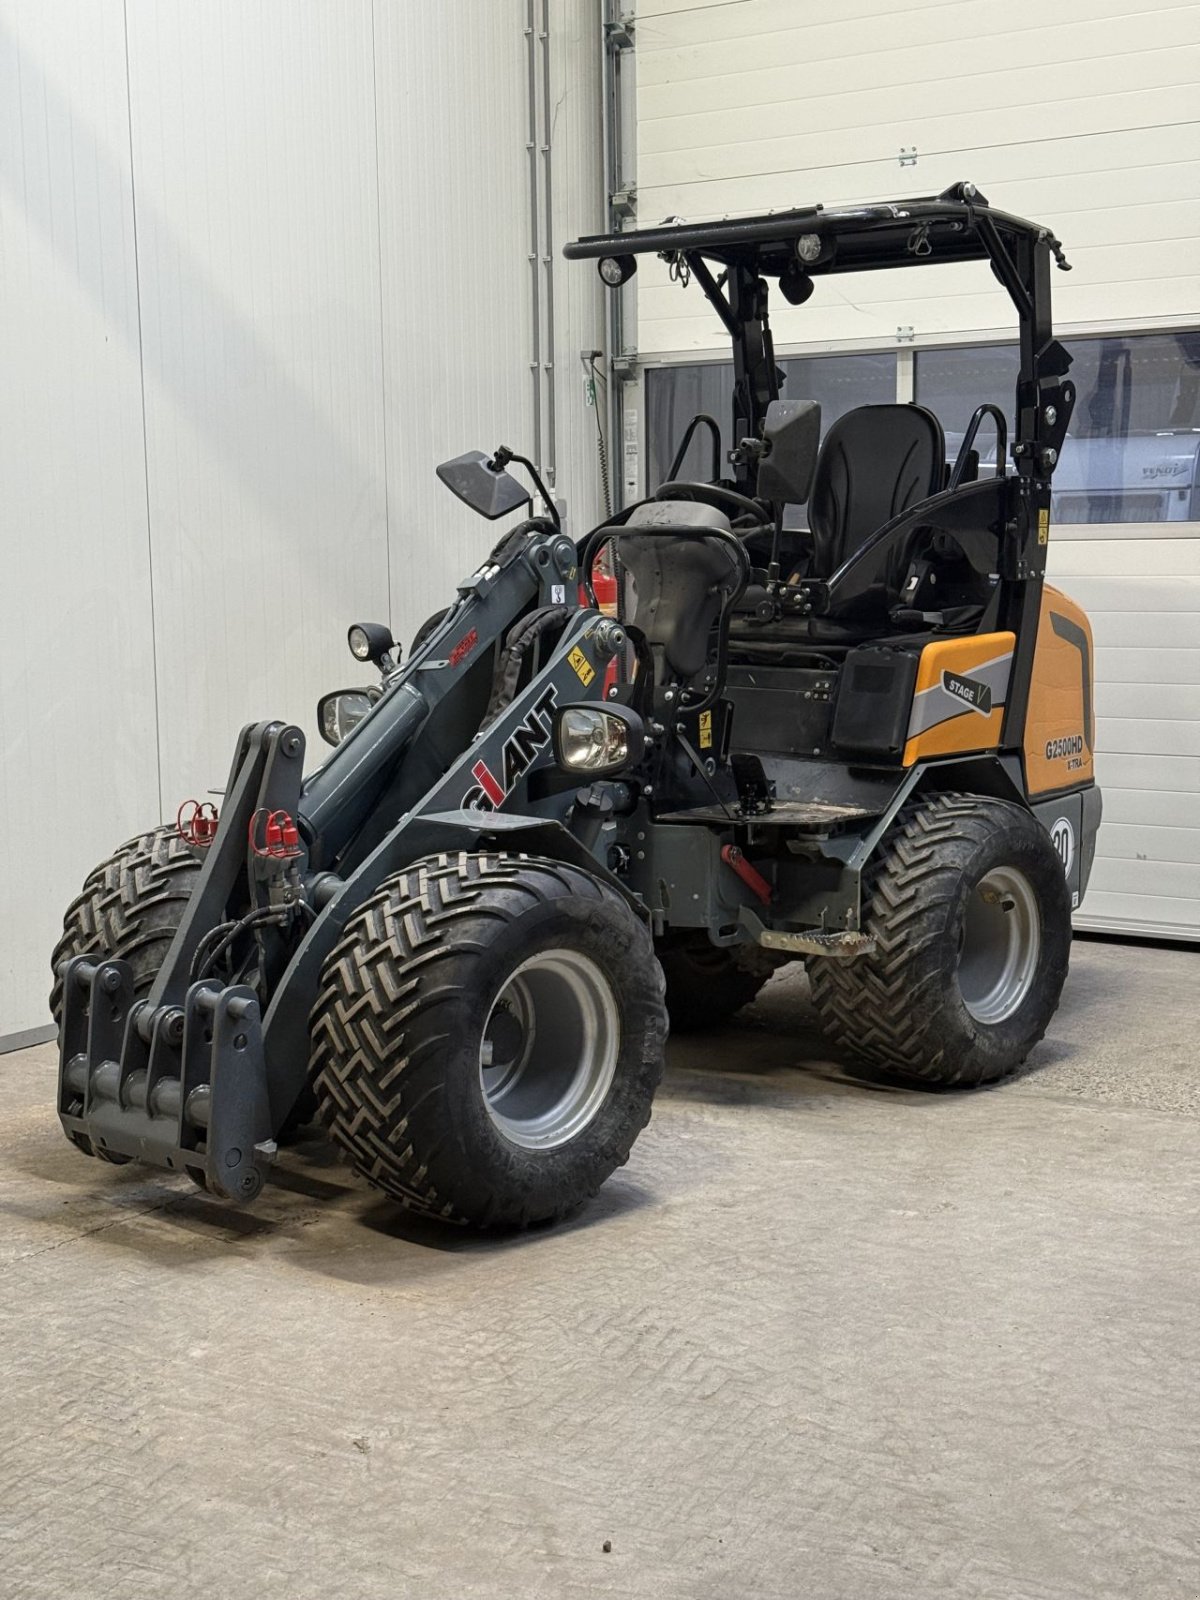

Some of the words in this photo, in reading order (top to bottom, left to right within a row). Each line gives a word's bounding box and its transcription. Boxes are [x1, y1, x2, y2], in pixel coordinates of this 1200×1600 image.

[949, 679, 975, 702] STAGE
[976, 684, 990, 705] V
[460, 682, 558, 814] GIANT
[1045, 735, 1083, 760] G2500HD
